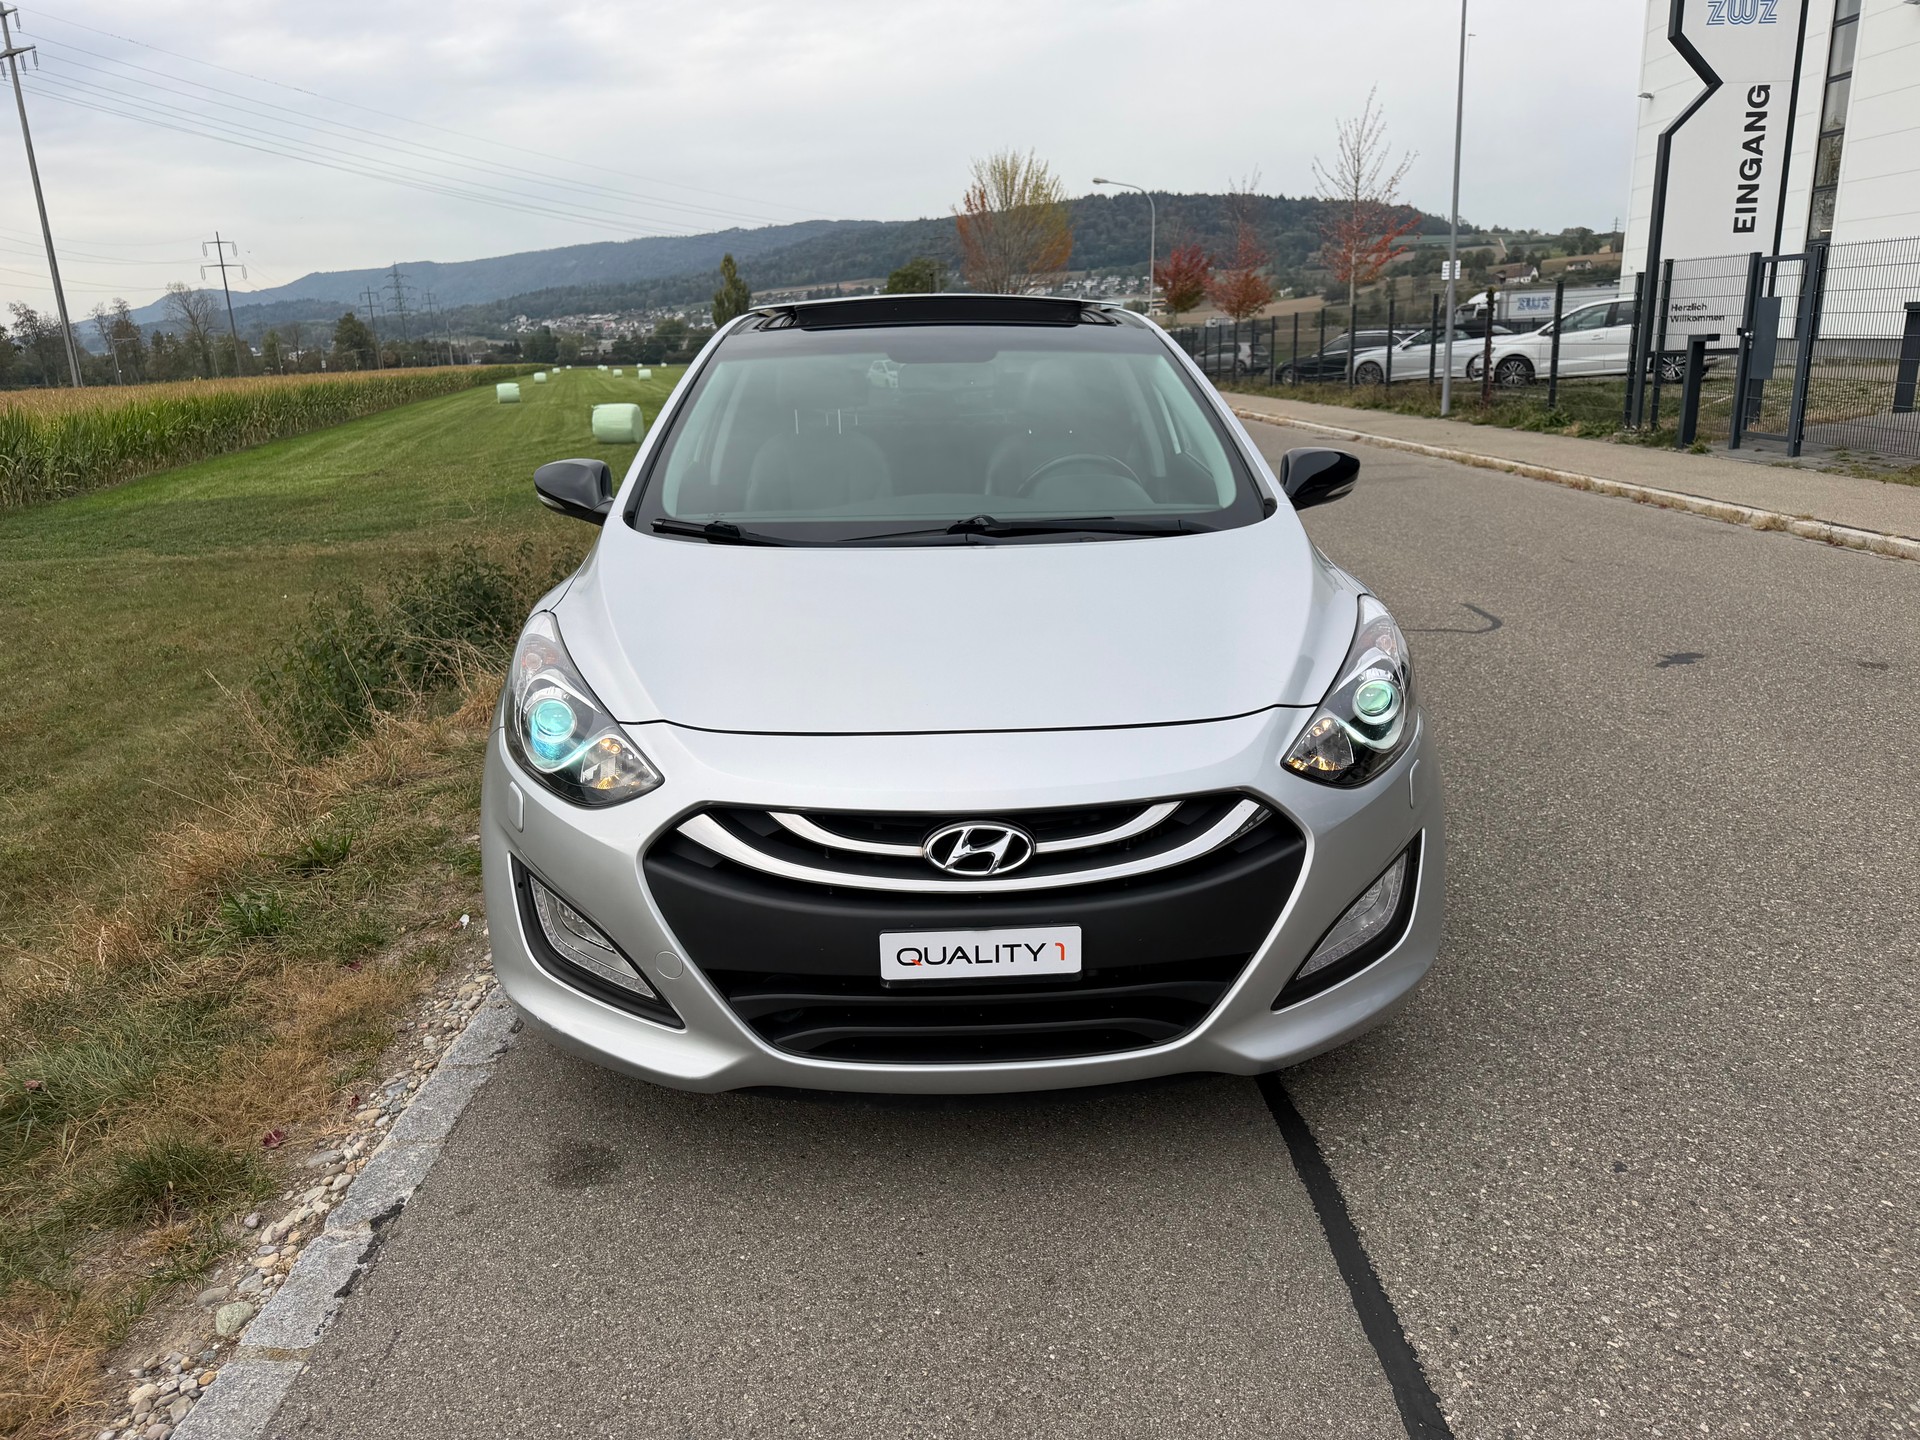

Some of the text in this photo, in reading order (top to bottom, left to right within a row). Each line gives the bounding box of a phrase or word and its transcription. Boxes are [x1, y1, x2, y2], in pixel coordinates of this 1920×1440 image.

[1733, 84, 1771, 233] EINGANG
[1671, 303, 1707, 312] Herzlich
[1670, 314, 1725, 323] Willkommen
[896, 942, 1066, 967] QUALITY 1
